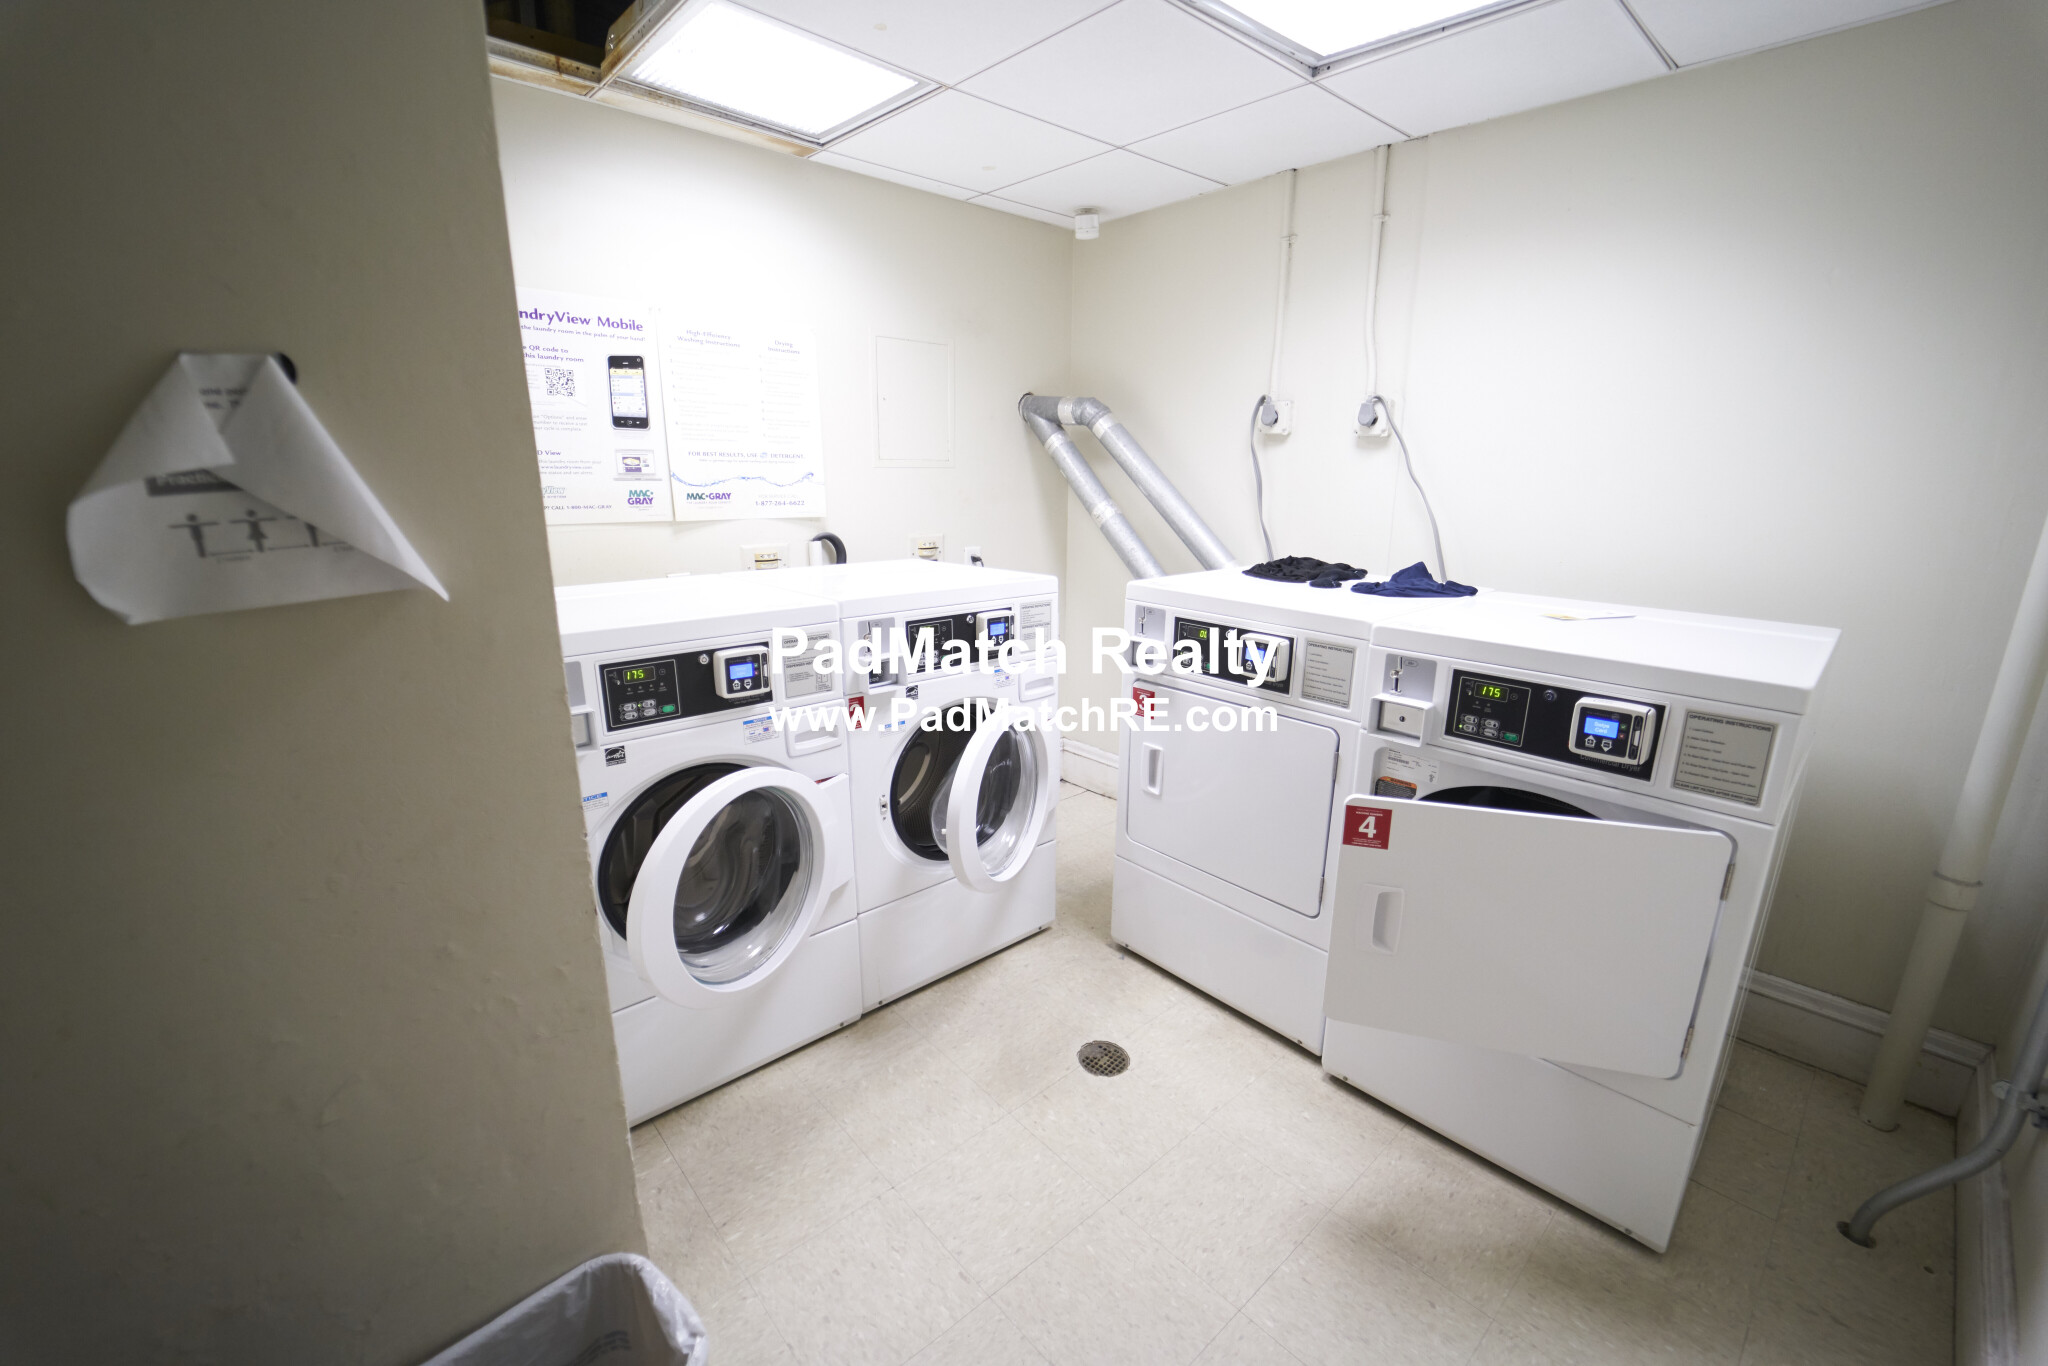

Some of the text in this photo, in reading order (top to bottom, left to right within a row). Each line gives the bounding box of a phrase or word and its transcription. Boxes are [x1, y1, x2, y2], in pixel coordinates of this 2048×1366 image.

[533, 325, 556, 333] laundry
[597, 316, 643, 331] Mobile
[677, 335, 741, 349] Washing Instructions
[774, 339, 793, 349] Drying
[767, 346, 800, 355] Instructions
[537, 353, 564, 362] laundry
[627, 497, 654, 506] GRAY
[627, 669, 644, 681] 175
[1482, 686, 1501, 698] 175
[1688, 714, 1772, 732] OPERATING INSTRUCTIONS
[1580, 754, 1641, 772] Commercial Dryer
[1358, 816, 1377, 839] 4
